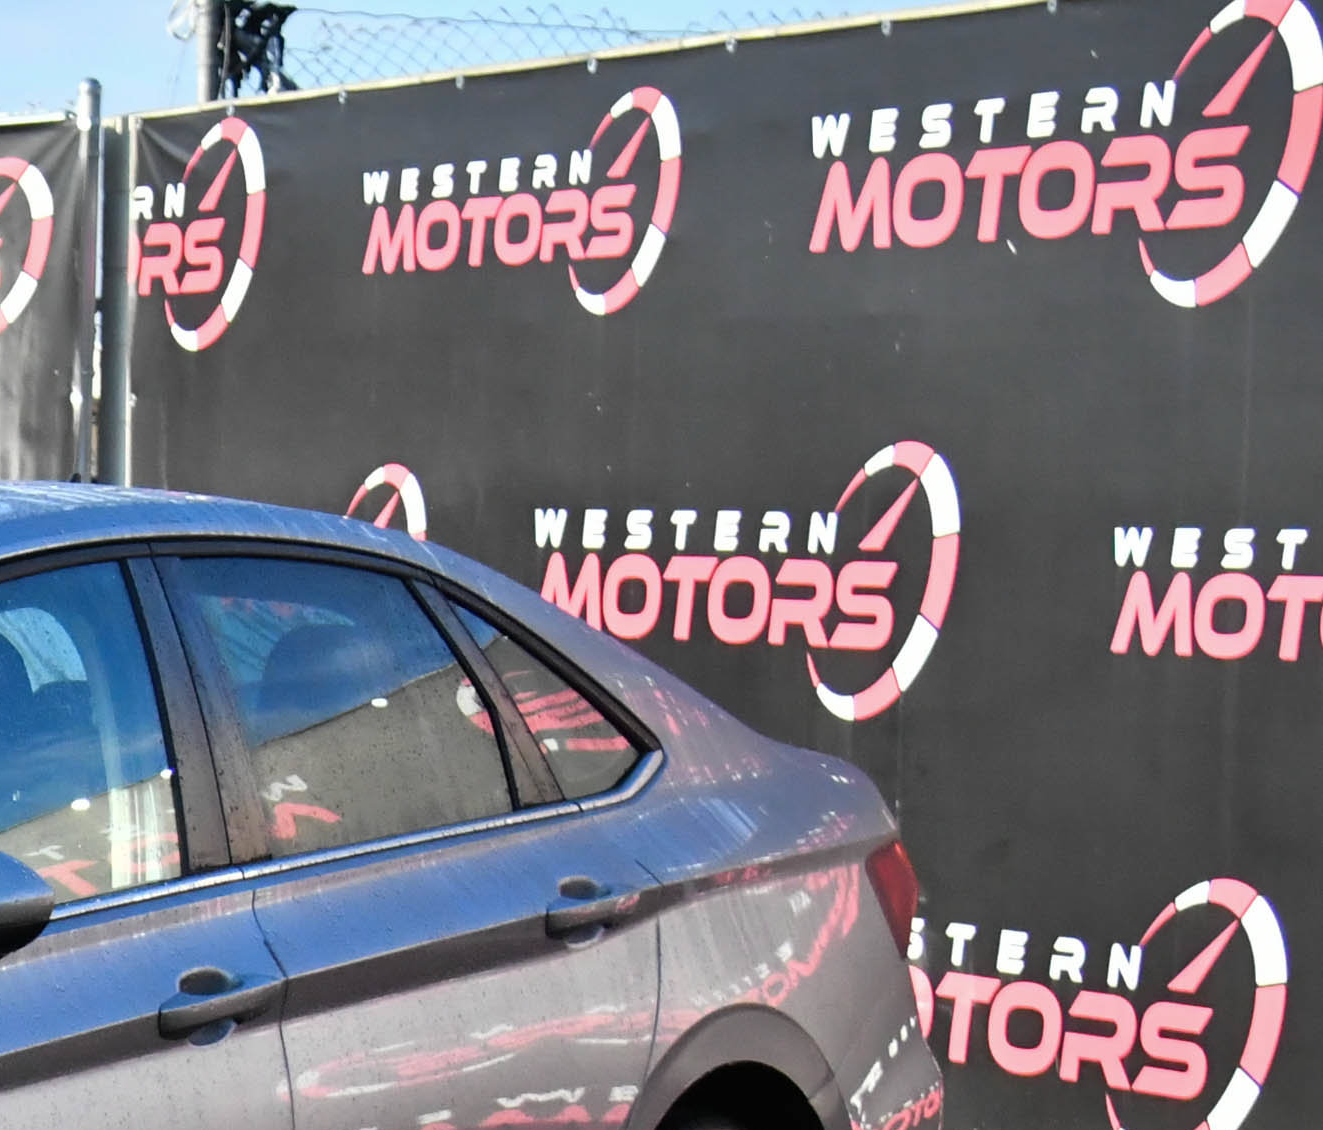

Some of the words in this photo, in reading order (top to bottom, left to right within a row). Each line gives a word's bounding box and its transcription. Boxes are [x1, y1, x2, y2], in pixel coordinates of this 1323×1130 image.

[811, 79, 1177, 159] WESTERN
[362, 149, 593, 205] WESTERN
[808, 124, 1251, 254] MOTORS
[361, 184, 637, 275] MOTORS
[534, 508, 839, 554] WESTERN
[1114, 526, 1309, 570] WEST
[540, 551, 898, 651] MOTORS
[1110, 570, 1323, 662] MOT
